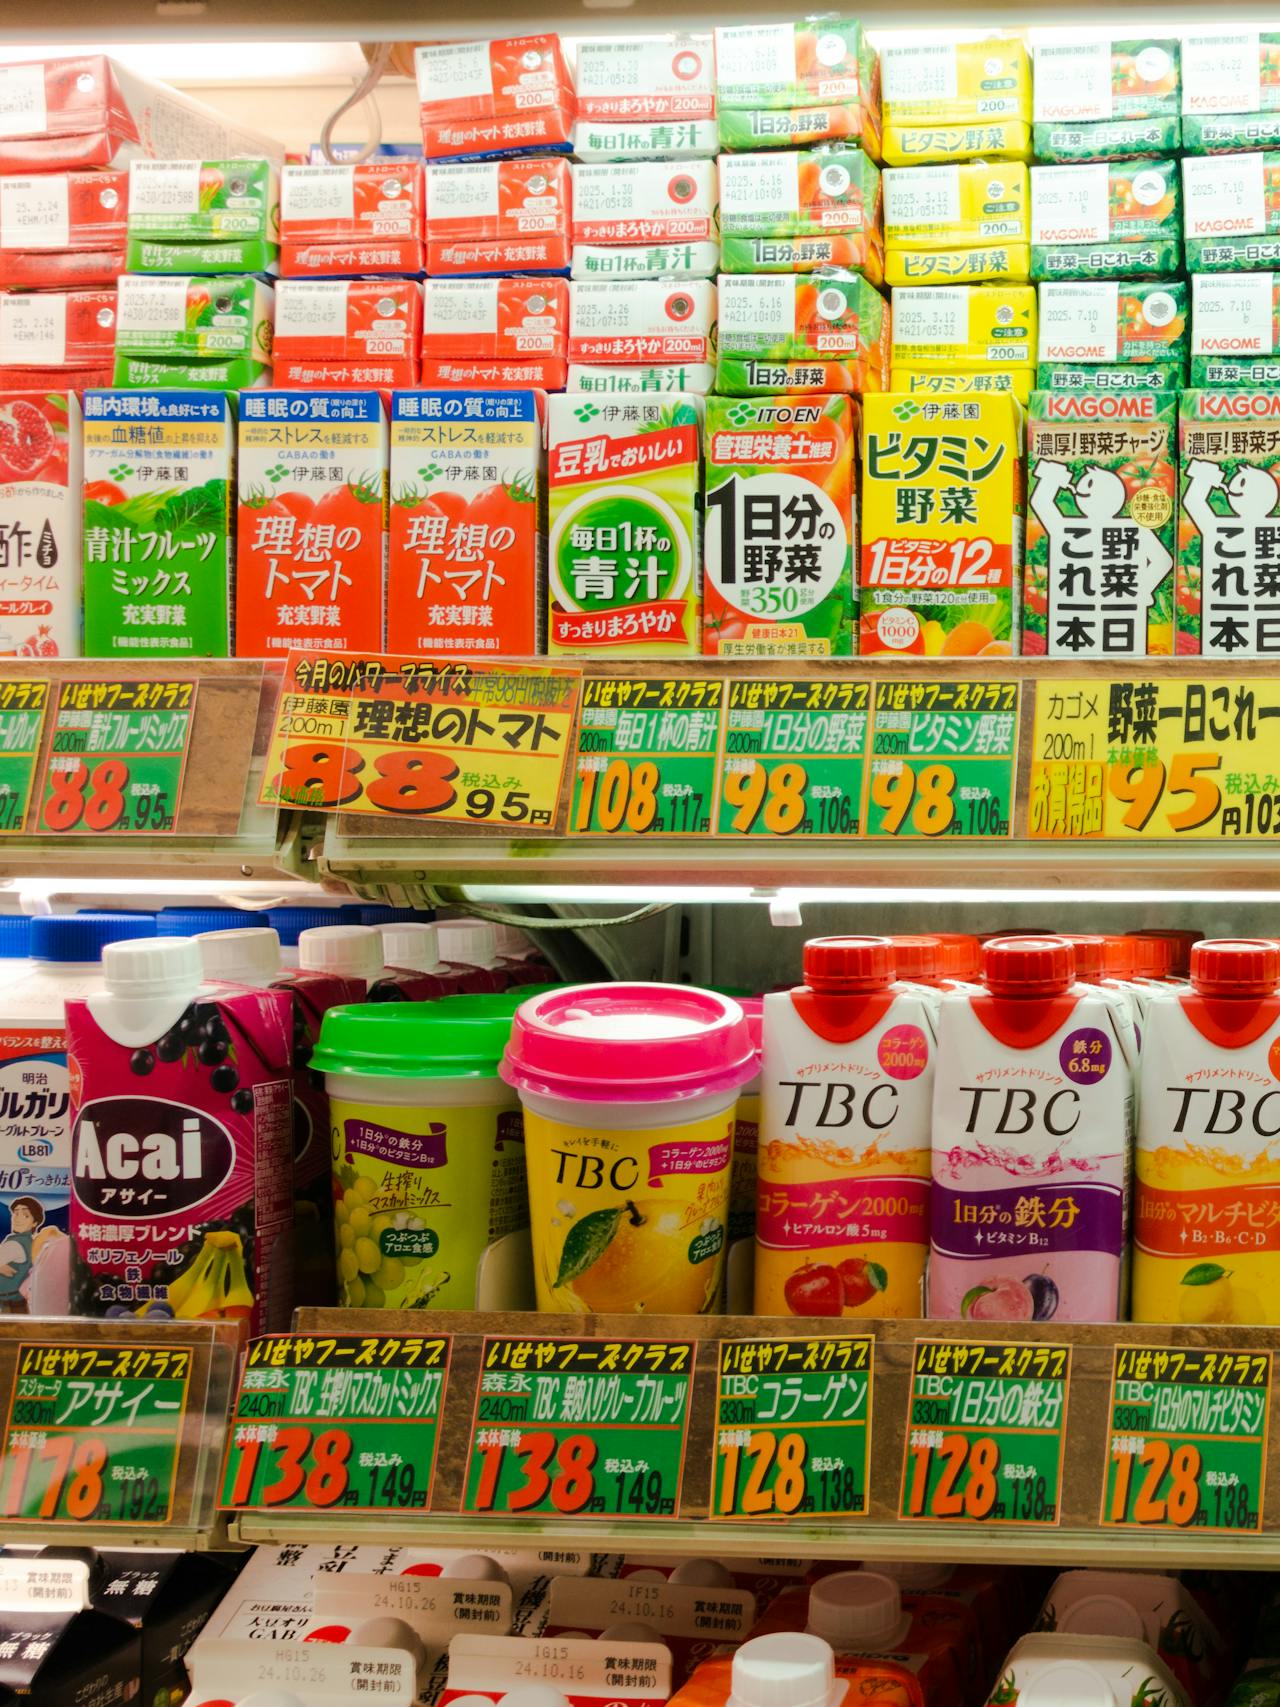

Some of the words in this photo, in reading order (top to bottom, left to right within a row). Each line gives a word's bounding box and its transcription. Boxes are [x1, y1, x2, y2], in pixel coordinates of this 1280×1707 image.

[503, 120, 547, 139] 充実野菜
[582, 218, 667, 239] すっきりまろやか
[585, 246, 698, 271] 毎日1杯の青汁
[752, 237, 832, 263] 1日分の野菜
[903, 249, 1010, 276] ビタミン野菜
[1046, 344, 1106, 359] KAGOME
[85, 397, 220, 417] 腸内環境を良好にする
[602, 405, 659, 422] 伊藤園
[1048, 396, 1154, 418] KAGOME
[554, 438, 684, 479] 豆乳でおいしい
[867, 432, 1005, 482] ビタミン
[137, 466, 189, 481] 伊藤園
[895, 486, 979, 525] 野菜
[84, 527, 217, 563] 青汁フルーツ
[251, 515, 362, 563] 理想の
[569, 521, 672, 552] 毎日1杯の
[111, 569, 192, 597] ミックス
[264, 561, 354, 601] トマト
[570, 555, 669, 601] 青汁
[1055, 527, 1097, 653] これ一本
[1100, 527, 1140, 653] 野菜一日
[1209, 527, 1250, 653] これ一本
[122, 604, 188, 627] 充実野菜
[558, 610, 677, 640] すっきりまろやか
[1047, 691, 1099, 720] カゴメ
[354, 700, 562, 751] 理想のトマト
[1072, 1039, 1103, 1055] 鉄分
[22, 1072, 49, 1086] 明治
[1068, 1058, 1106, 1075] 6.8mg
[778, 1081, 900, 1130] TBC
[958, 1086, 1082, 1137] TBC
[22, 1144, 49, 1158] LB81
[75, 1117, 205, 1181] Acai
[550, 1147, 640, 1192] TBC
[100, 1189, 168, 1206] アサイー
[78, 1223, 202, 1243] 本格濃厚ブレンド
[87, 1248, 185, 1266] ポリフェノール
[100, 1285, 170, 1301] 食物繊維
[242, 1370, 291, 1389] 森永
[55, 1381, 181, 1427] アサイー
[757, 1373, 868, 1421] コラーゲン
[605, 1656, 659, 1672] 賞味期限
